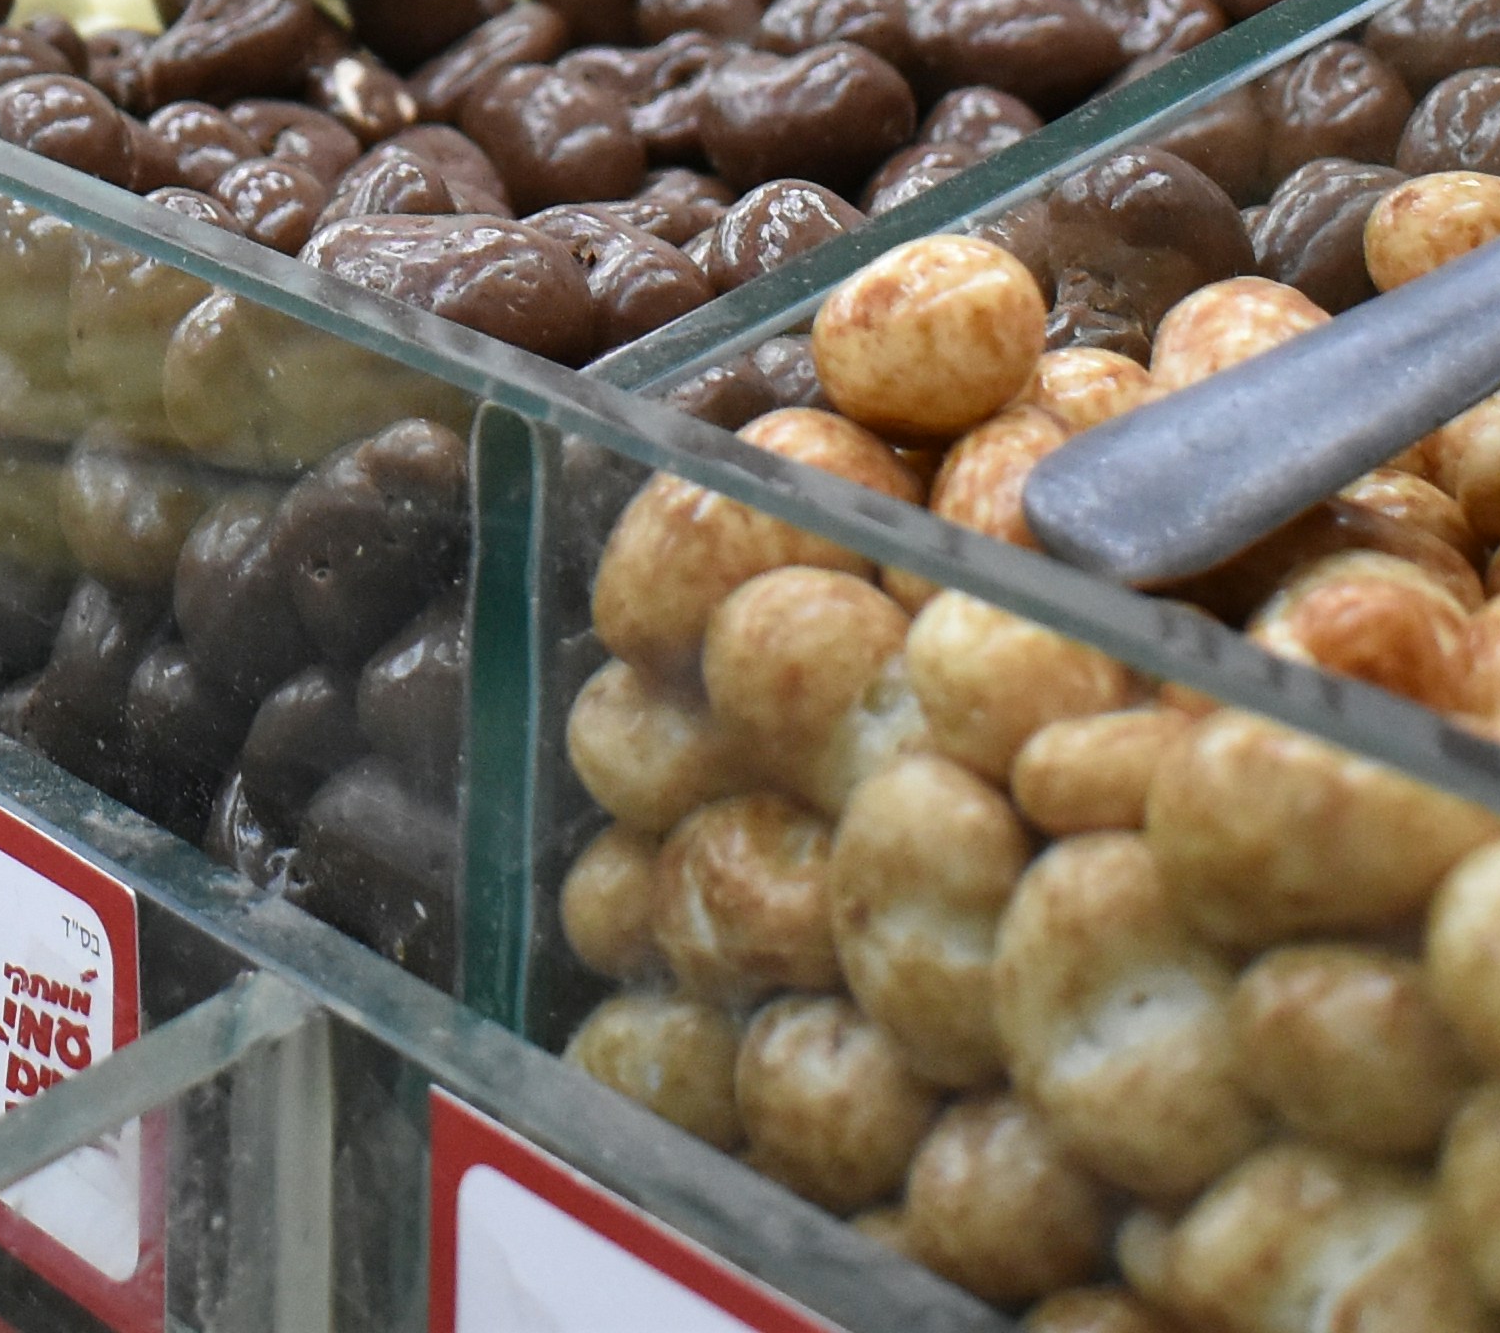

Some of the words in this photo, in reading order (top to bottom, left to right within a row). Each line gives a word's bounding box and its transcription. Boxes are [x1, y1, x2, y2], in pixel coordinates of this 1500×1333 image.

[61, 915, 102, 958] בס"ד
[4, 962, 92, 1017] ממתקי
[3, 997, 92, 1071] סמי
